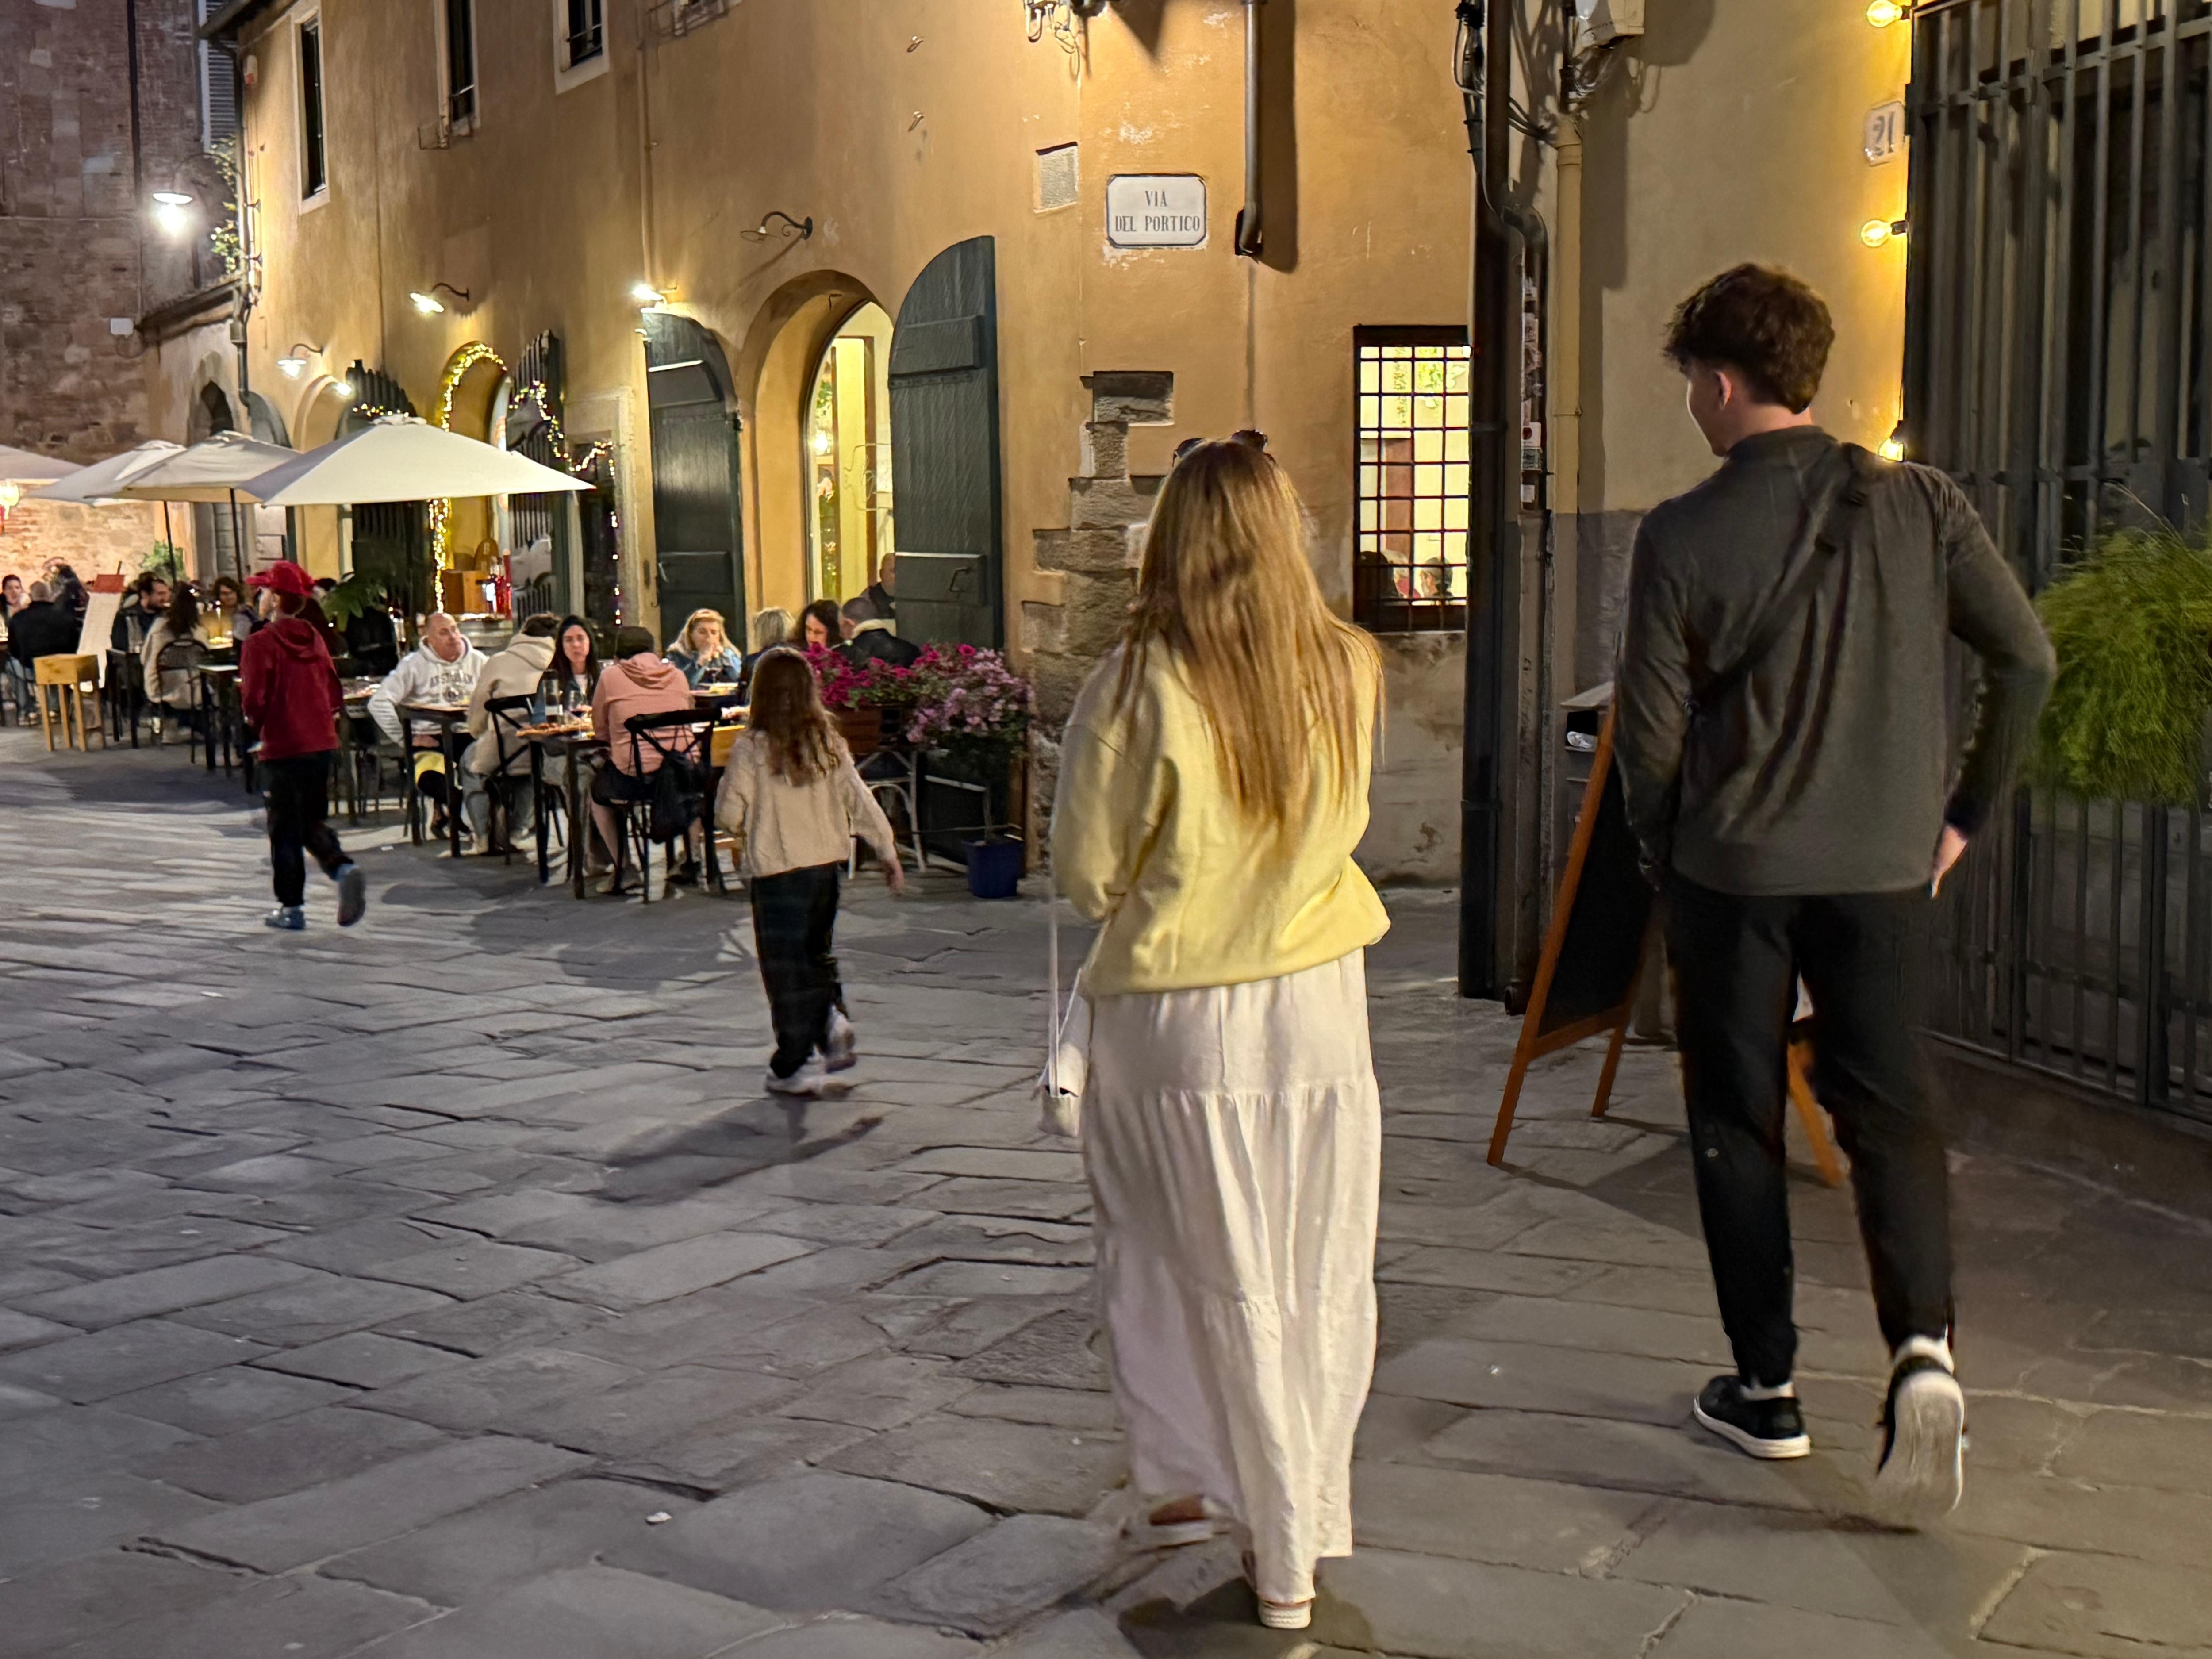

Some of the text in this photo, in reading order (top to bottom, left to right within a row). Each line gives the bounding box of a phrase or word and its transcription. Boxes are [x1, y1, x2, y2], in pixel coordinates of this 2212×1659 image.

[1145, 190, 1167, 207] VIA
[1115, 215, 1200, 231] DEL PORTICO
